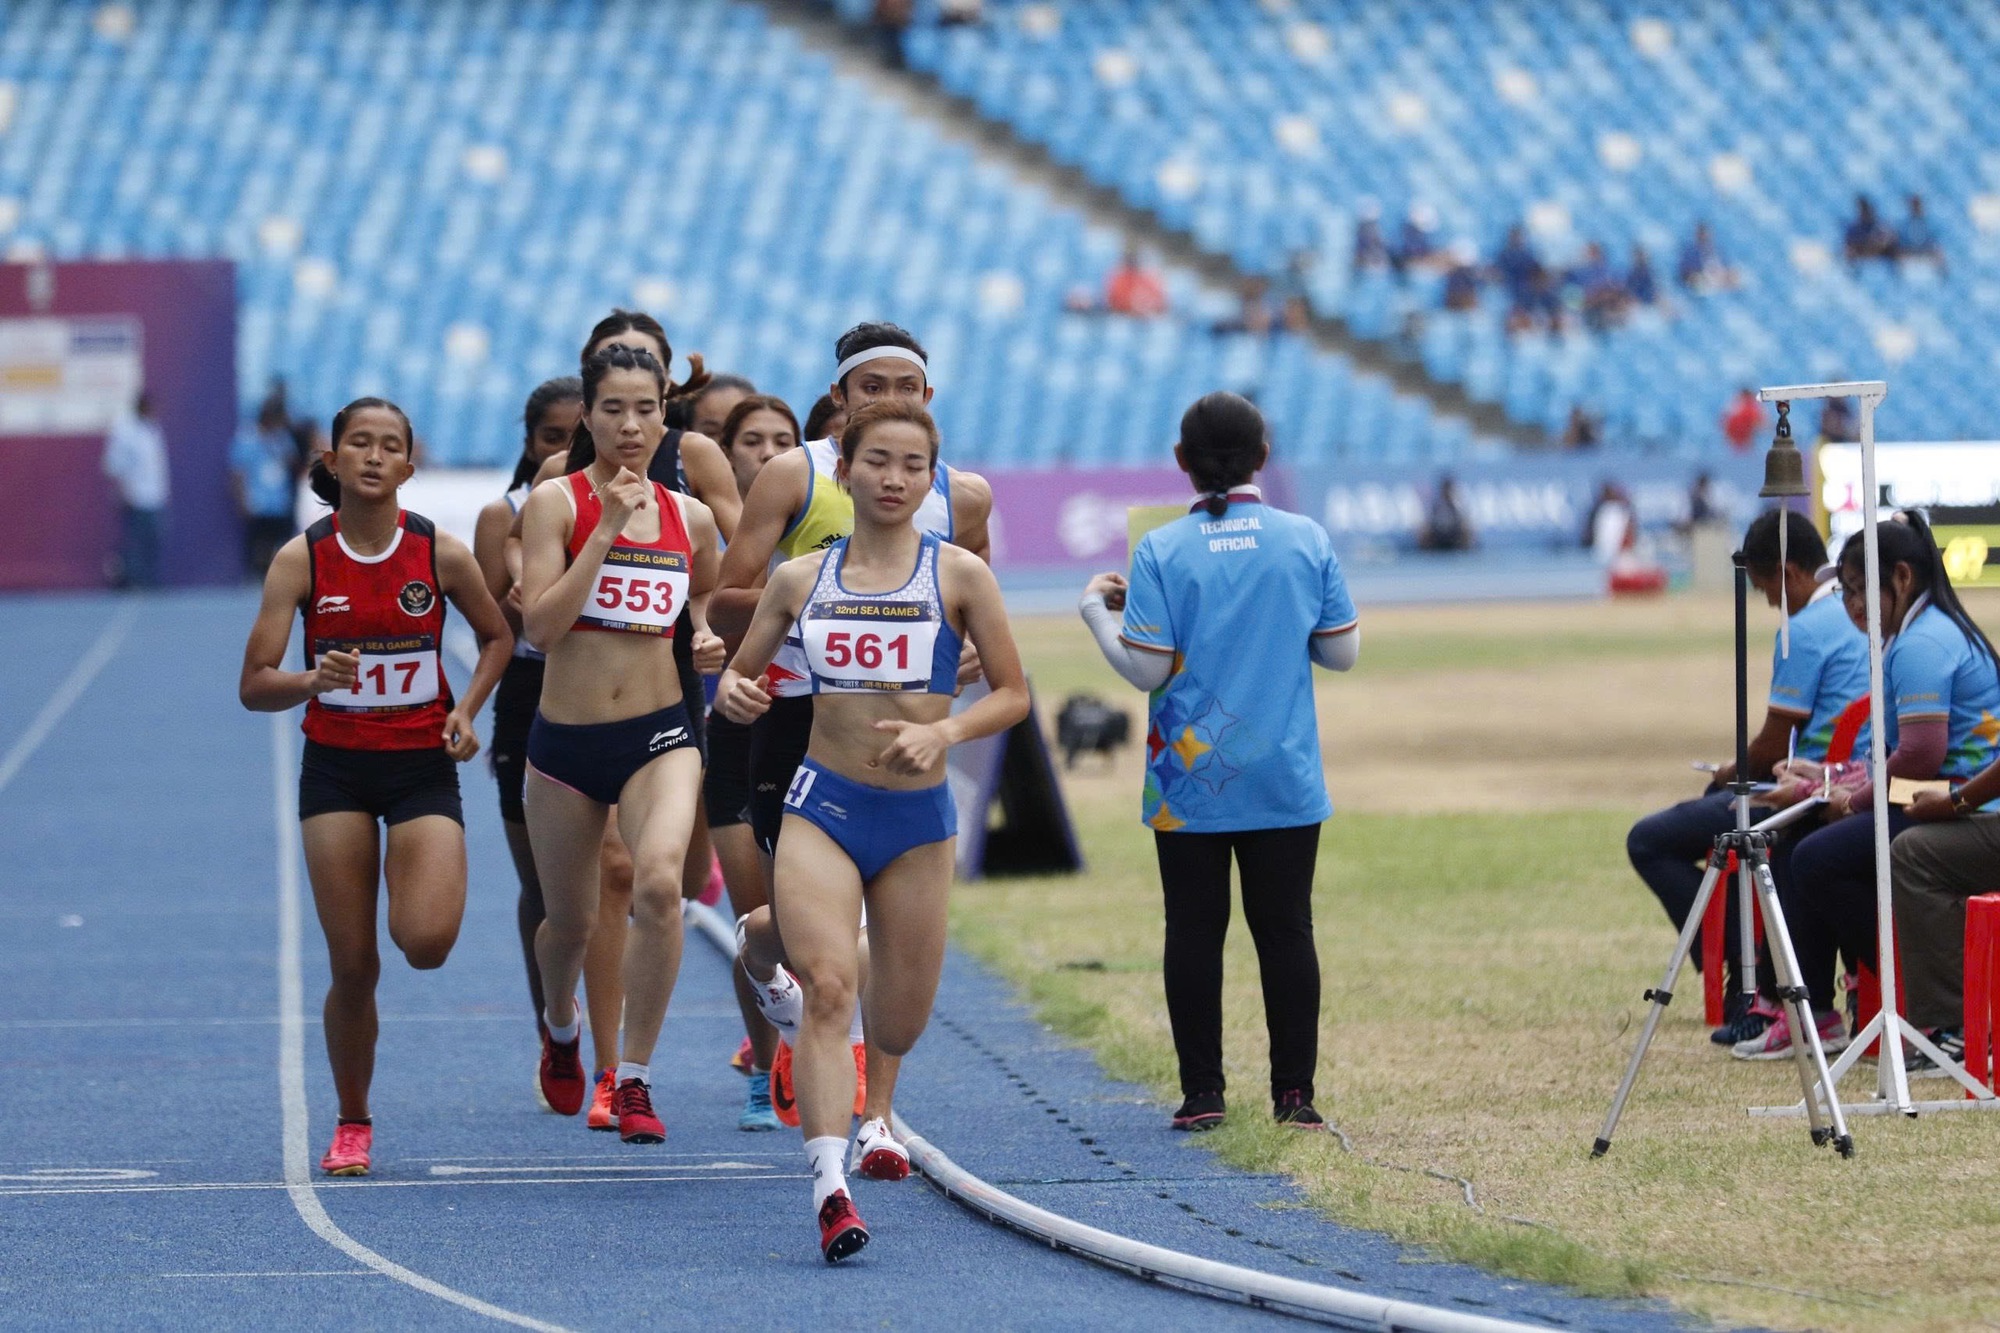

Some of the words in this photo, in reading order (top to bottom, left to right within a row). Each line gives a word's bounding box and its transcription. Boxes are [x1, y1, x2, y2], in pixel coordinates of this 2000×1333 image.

[1199, 517, 1263, 535] TECHNICAL
[1209, 535, 1260, 553] OFFICIAL
[608, 552, 631, 562] 32nd
[633, 553, 651, 563] SEA
[652, 555, 679, 567] GAMES
[596, 576, 673, 615] 553
[835, 605, 858, 615] 32nd
[860, 605, 880, 616] SEA
[882, 606, 920, 617] GAMES
[366, 641, 385, 650] SEA
[386, 639, 422, 651] GAMES
[824, 632, 909, 669] 561
[649, 732, 689, 752] LI-NING
[788, 770, 810, 804] 4
